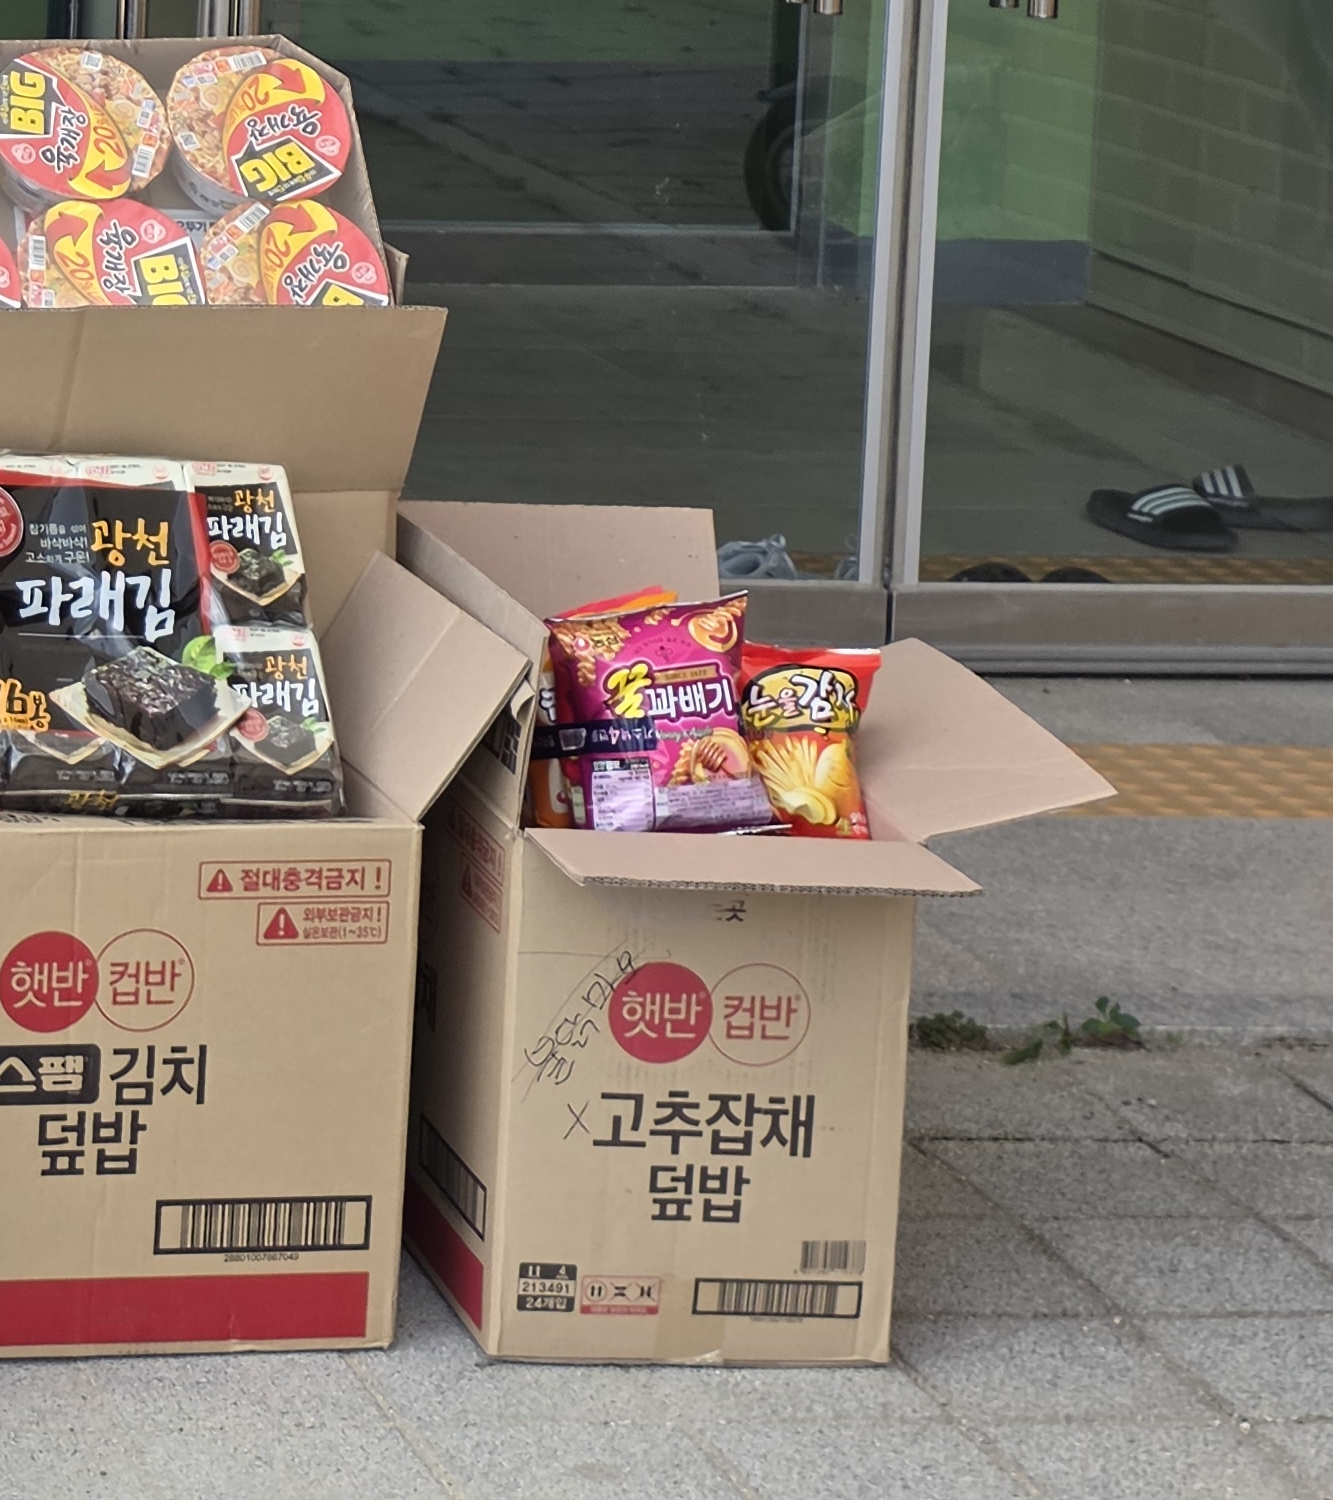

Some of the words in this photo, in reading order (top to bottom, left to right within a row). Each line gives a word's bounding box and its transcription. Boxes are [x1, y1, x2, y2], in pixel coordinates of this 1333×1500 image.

[10, 70, 46, 135] BIG
[239, 142, 316, 193] BIG
[234, 488, 276, 513] 광천
[91, 517, 171, 567] 광천
[206, 511, 287, 549] 파래김
[15, 567, 176, 643] 파래김
[265, 654, 308, 680] 광천
[606, 663, 733, 719] 꿀꽈배기
[240, 866, 367, 892] 절대충격금지
[10, 959, 90, 1009] 햇반
[108, 959, 182, 1007] 컵반
[620, 989, 703, 1040] 햇반
[722, 995, 797, 1041] 컵반
[108, 1043, 208, 1105] 김치
[37, 1110, 148, 1177] 덮밥
[592, 1090, 816, 1159] 고추잡채
[648, 1163, 751, 1223] 덮밥
[521, 1280, 570, 1295] 213491
